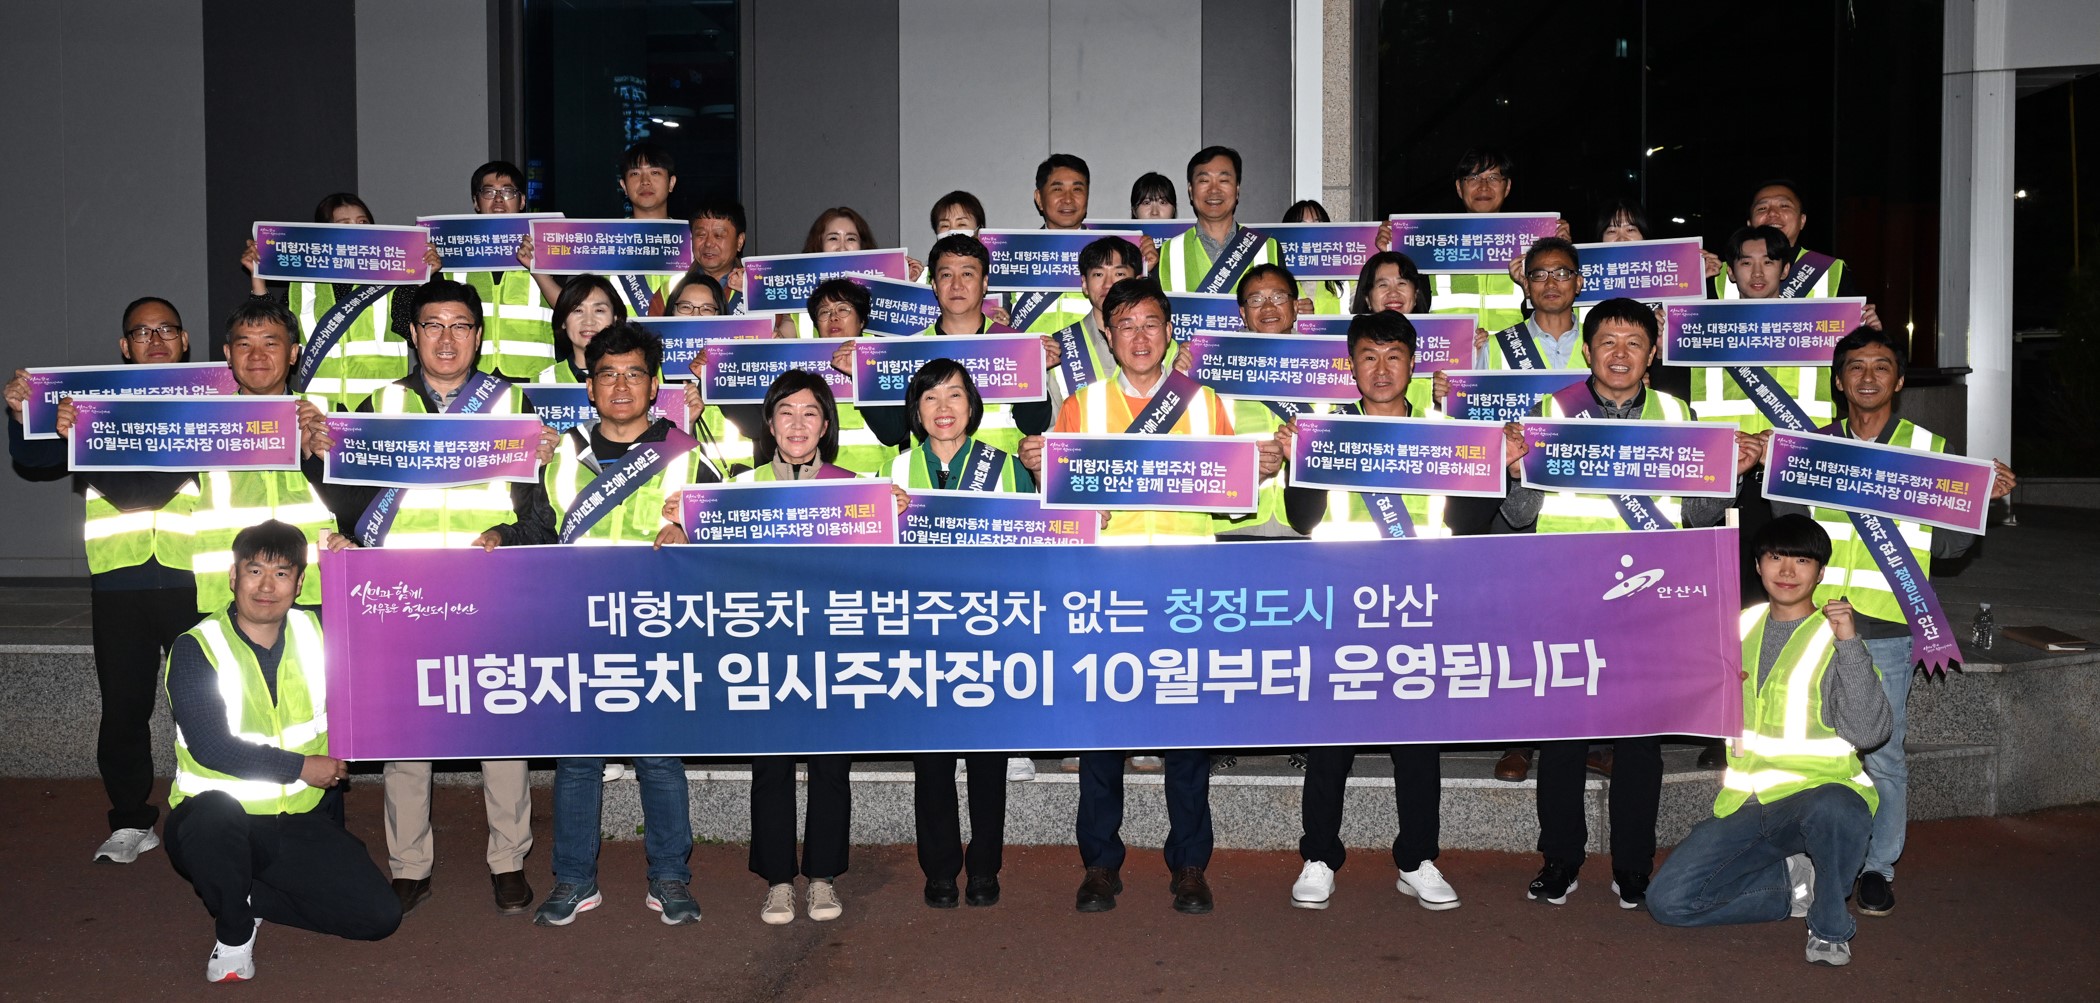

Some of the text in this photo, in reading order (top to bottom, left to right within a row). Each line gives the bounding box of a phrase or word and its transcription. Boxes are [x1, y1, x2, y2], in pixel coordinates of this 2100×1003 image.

[448, 235, 490, 244] 대형자동차
[1404, 235, 1458, 246] 대형자동차
[1461, 234, 1516, 246] 불법주정차
[335, 245, 381, 259] 불법주차
[384, 247, 406, 258] 없는
[465, 246, 513, 256] 임시주차장
[1302, 242, 1343, 253] 불법주차
[1346, 242, 1366, 252] 없는
[1434, 248, 1514, 261] 청정도시 안산
[278, 255, 301, 266] 청정
[305, 256, 329, 268] 안산
[332, 258, 354, 268] 함께
[992, 251, 1012, 261] 안산,
[1015, 252, 1059, 261] 대형자동차
[1298, 255, 1318, 266] 함께
[1607, 261, 1654, 277] 불법주차
[1656, 260, 1678, 272] 없는
[1601, 274, 1625, 290] 함께
[1779, 264, 1815, 298] 대형자동
[766, 285, 787, 299] 청정
[874, 298, 917, 314] 대형자동차
[1170, 314, 1203, 328] 자동차
[1682, 321, 1844, 334] 안산, 대형자동차 불법주정차 제로!
[1428, 337, 1450, 348] 없는
[1677, 336, 1844, 348] 10월부터 임시주차장 이용하세요
[718, 363, 739, 372] 안산,
[742, 362, 787, 372] 대형자동차
[993, 358, 1017, 371] 없는
[1203, 354, 1353, 370] 안산, 대형자동차 불법주정차 제로
[714, 376, 756, 387] 10월부터
[879, 375, 904, 389] 청정
[1197, 369, 1304, 384] 10월부터 임시주차장
[92, 421, 278, 435] 안산, 대형자동차 불법주정차 제로!
[86, 437, 285, 451] 10월부터 임시주차장 이용하세요!
[342, 438, 524, 453] 안산, 대형자동차 불법주정차 제로!
[1312, 441, 1486, 459] 안산, 대형자동차 불법주정차 제로!
[339, 450, 528, 469] 10월부터 임시주차장 이용하세요!
[1619, 445, 1674, 460] 불법주차
[1678, 447, 1705, 461] 없는
[602, 448, 660, 496] 대형자동차
[1141, 460, 1196, 476] 불법주차
[1200, 462, 1227, 477] 없는
[1305, 456, 1490, 476] 10월부터 임시주차장 이용하세요!
[1547, 457, 1575, 475] 청정
[1580, 458, 1611, 476] 안산
[1613, 462, 1640, 477] 함께
[1071, 475, 1099, 491] 청정
[1103, 474, 1135, 492] 안산
[1136, 477, 1163, 492] 함께
[1788, 456, 1968, 497] 안산, 대형자동차 불법주정차 제로!
[1780, 468, 1971, 512] 10월부터 임시주차장 이용하세요!
[699, 504, 875, 523] 안산, 대형자동차 불법주정차 제로!
[694, 521, 882, 540] 10월부터 임시주차장 이용하세요!
[907, 515, 1079, 534] 안산, 대형자동차 불법주정차 제로!
[900, 530, 952, 544] 10월부터
[1657, 585, 1707, 598] 안산시
[1880, 542, 1903, 570] 없는
[1894, 567, 1928, 615] 청정도시
[1918, 615, 1940, 641] 안산
[588, 584, 1438, 637] 대형자동차 불법주정차 없는 청정도시 안산
[417, 639, 1606, 714] 대형자동차 임시주차장이 10월부터 운영됩니다
